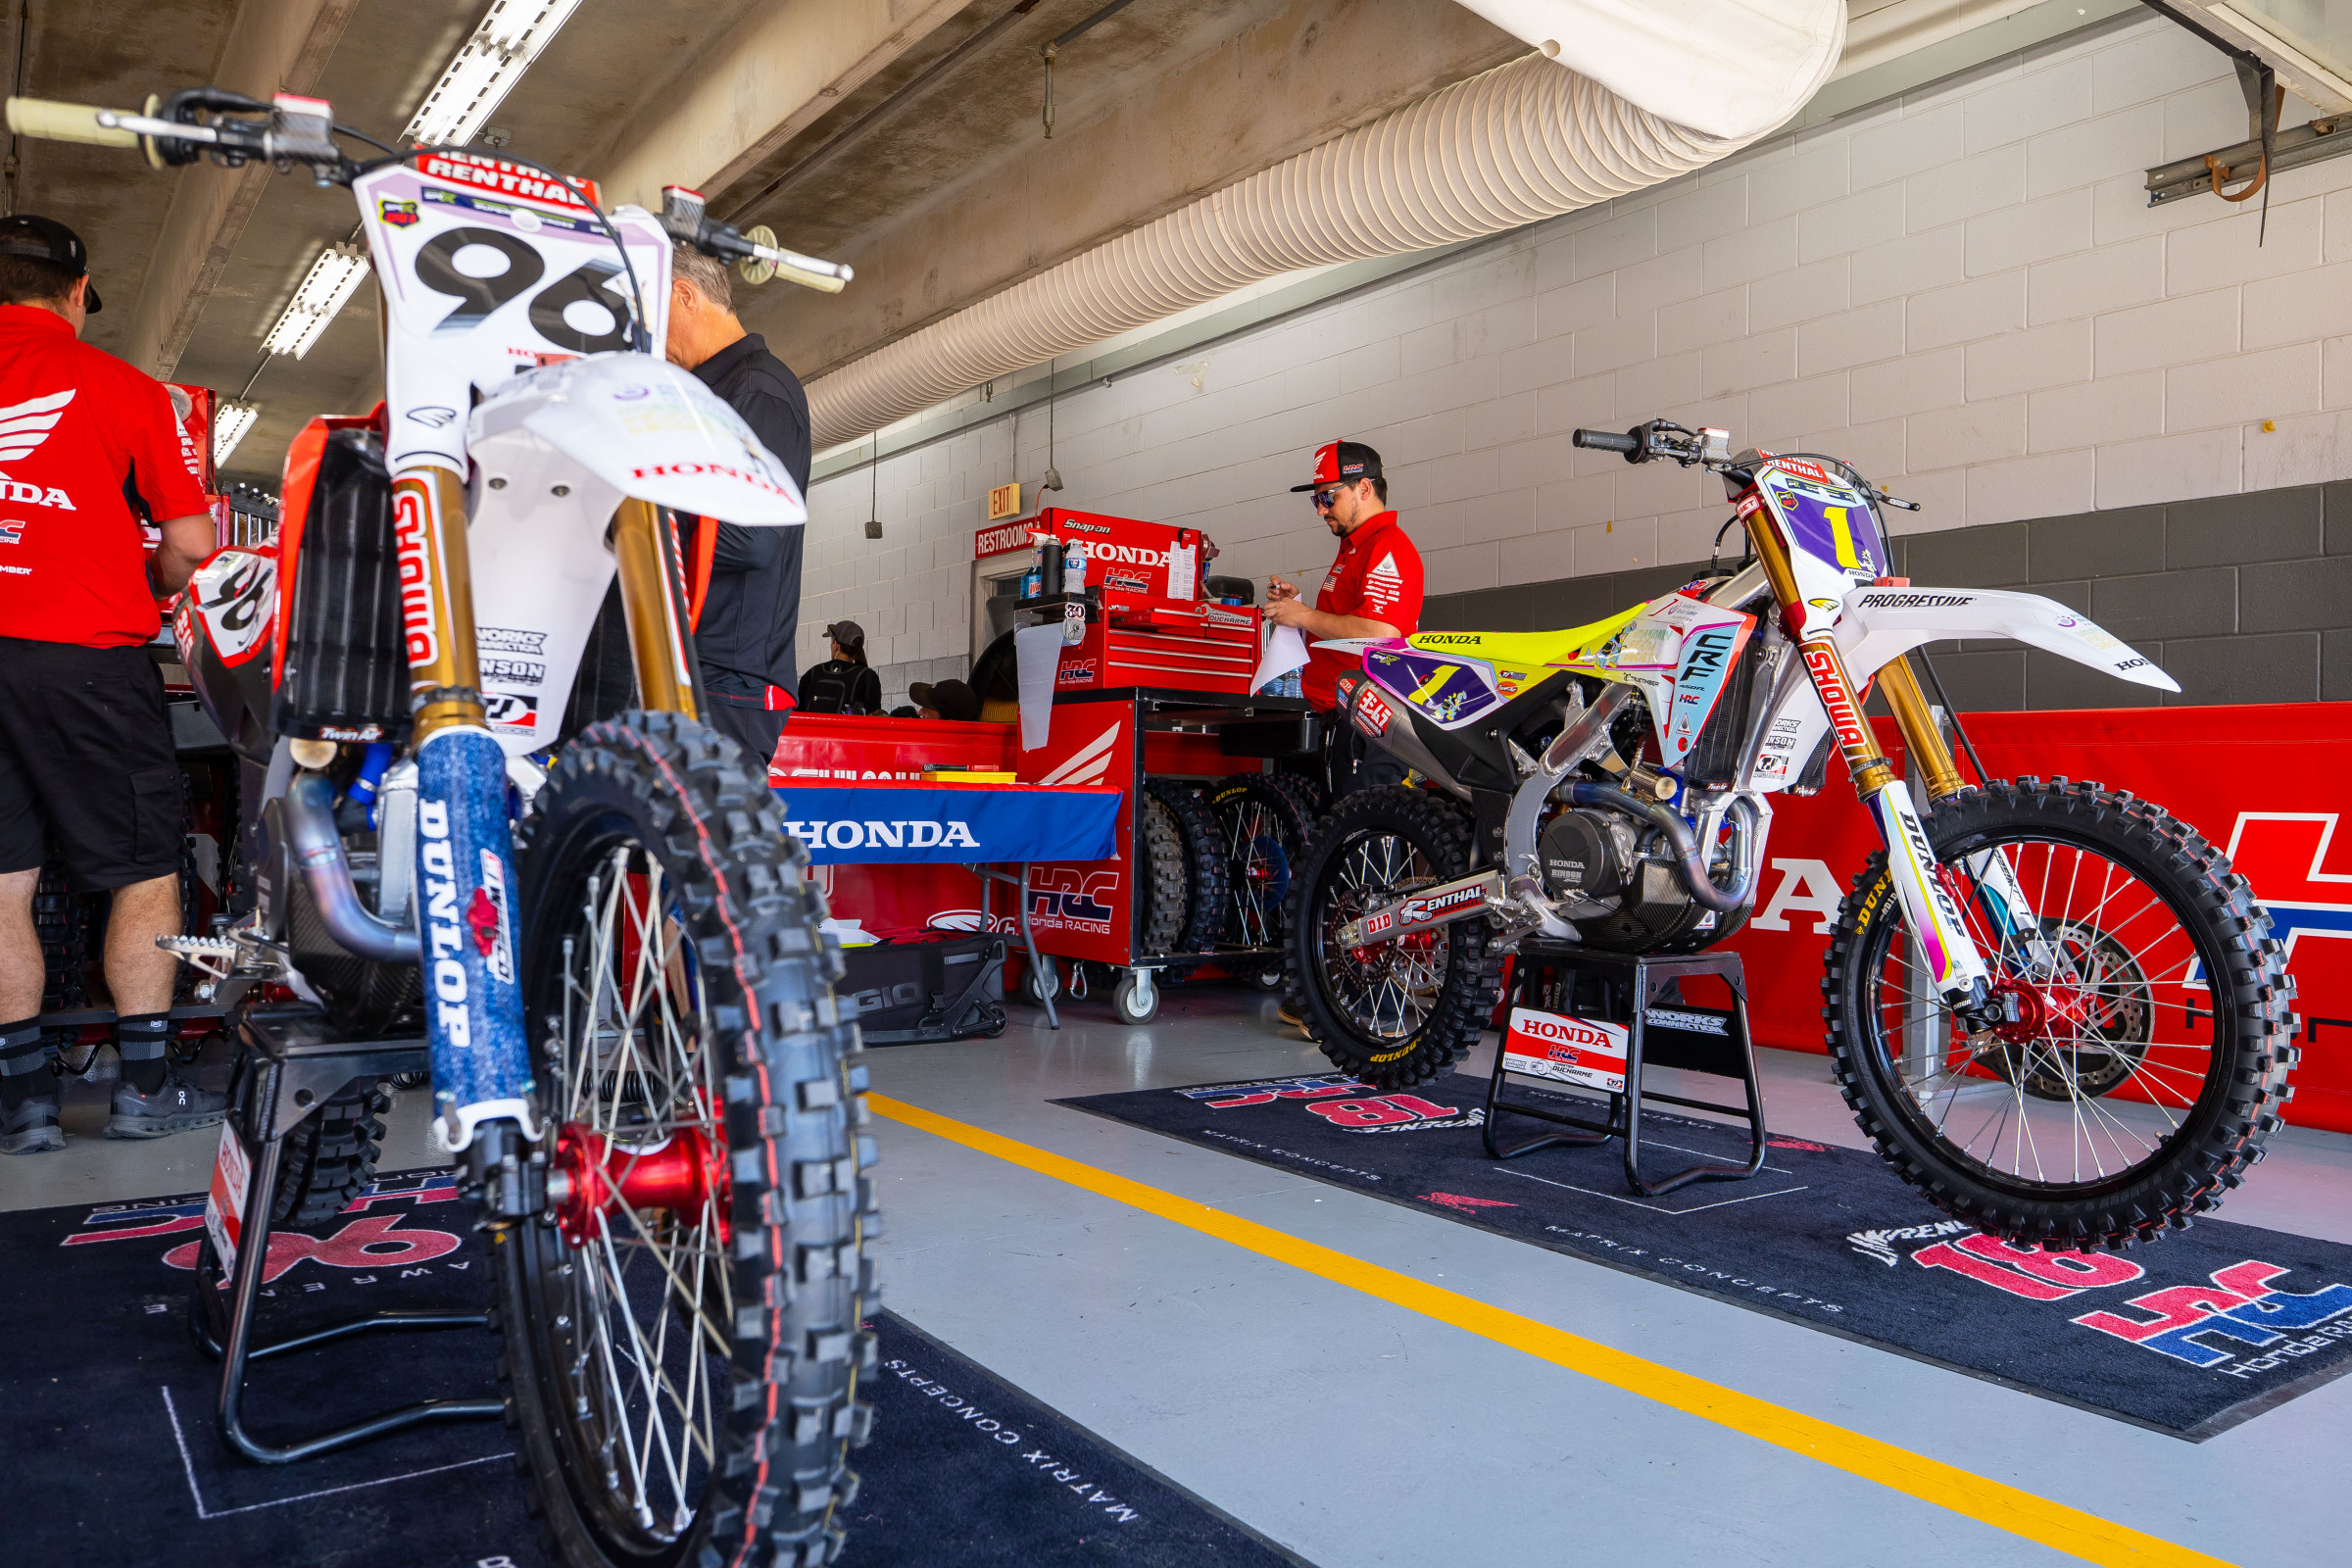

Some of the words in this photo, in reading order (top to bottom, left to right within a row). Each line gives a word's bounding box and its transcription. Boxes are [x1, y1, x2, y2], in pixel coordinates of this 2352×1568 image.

[415, 226, 636, 355] 96
[1767, 460, 1824, 478] RENTHAL
[631, 461, 800, 507] HONDA
[993, 486, 1010, 515] EXIT
[1063, 517, 1111, 534] Snap-on
[1824, 507, 1862, 570] 1
[393, 490, 438, 668] SHOWA
[1848, 569, 1875, 579] HONDA
[1858, 594, 1974, 608] PROGRESSIVE
[1208, 615, 1251, 626] DUCHARME
[1418, 635, 1482, 645] HONDA
[479, 659, 546, 678] NSON
[1060, 659, 1097, 679] HRC
[1680, 634, 1734, 681] CRF
[1408, 664, 1461, 706] 1
[1679, 694, 1700, 705] HRC
[1804, 651, 1867, 748] SHOWA
[1215, 787, 1248, 803] DUNLOP
[783, 820, 981, 850] HONDA
[1549, 859, 1586, 868] HONDA
[1900, 811, 1965, 938] DUNLOP
[1029, 866, 1120, 923] HRC
[418, 798, 470, 1048] DUNLOP
[1064, 920, 1110, 935] RACING
[852, 982, 923, 1013] GIO
[1645, 1008, 1728, 1025] WORKS
[1645, 1017, 1730, 1037] CONNECTION
[1522, 1018, 1612, 1049] HONDA
[1370, 1041, 1418, 1062] DUNLOP
[1547, 1045, 1581, 1062] HRC
[1552, 1065, 1593, 1079] DUCHARME
[1305, 1094, 1460, 1128] 18
[1203, 1130, 1266, 1149] MATRIX
[1272, 1149, 1381, 1181] CONCEPTS
[1544, 1225, 1648, 1255] MATRIX
[1659, 1256, 1844, 1313] CONCEPTS
[884, 1358, 1021, 1445] CONCEPTS
[1022, 1448, 1140, 1523] MATRIX
